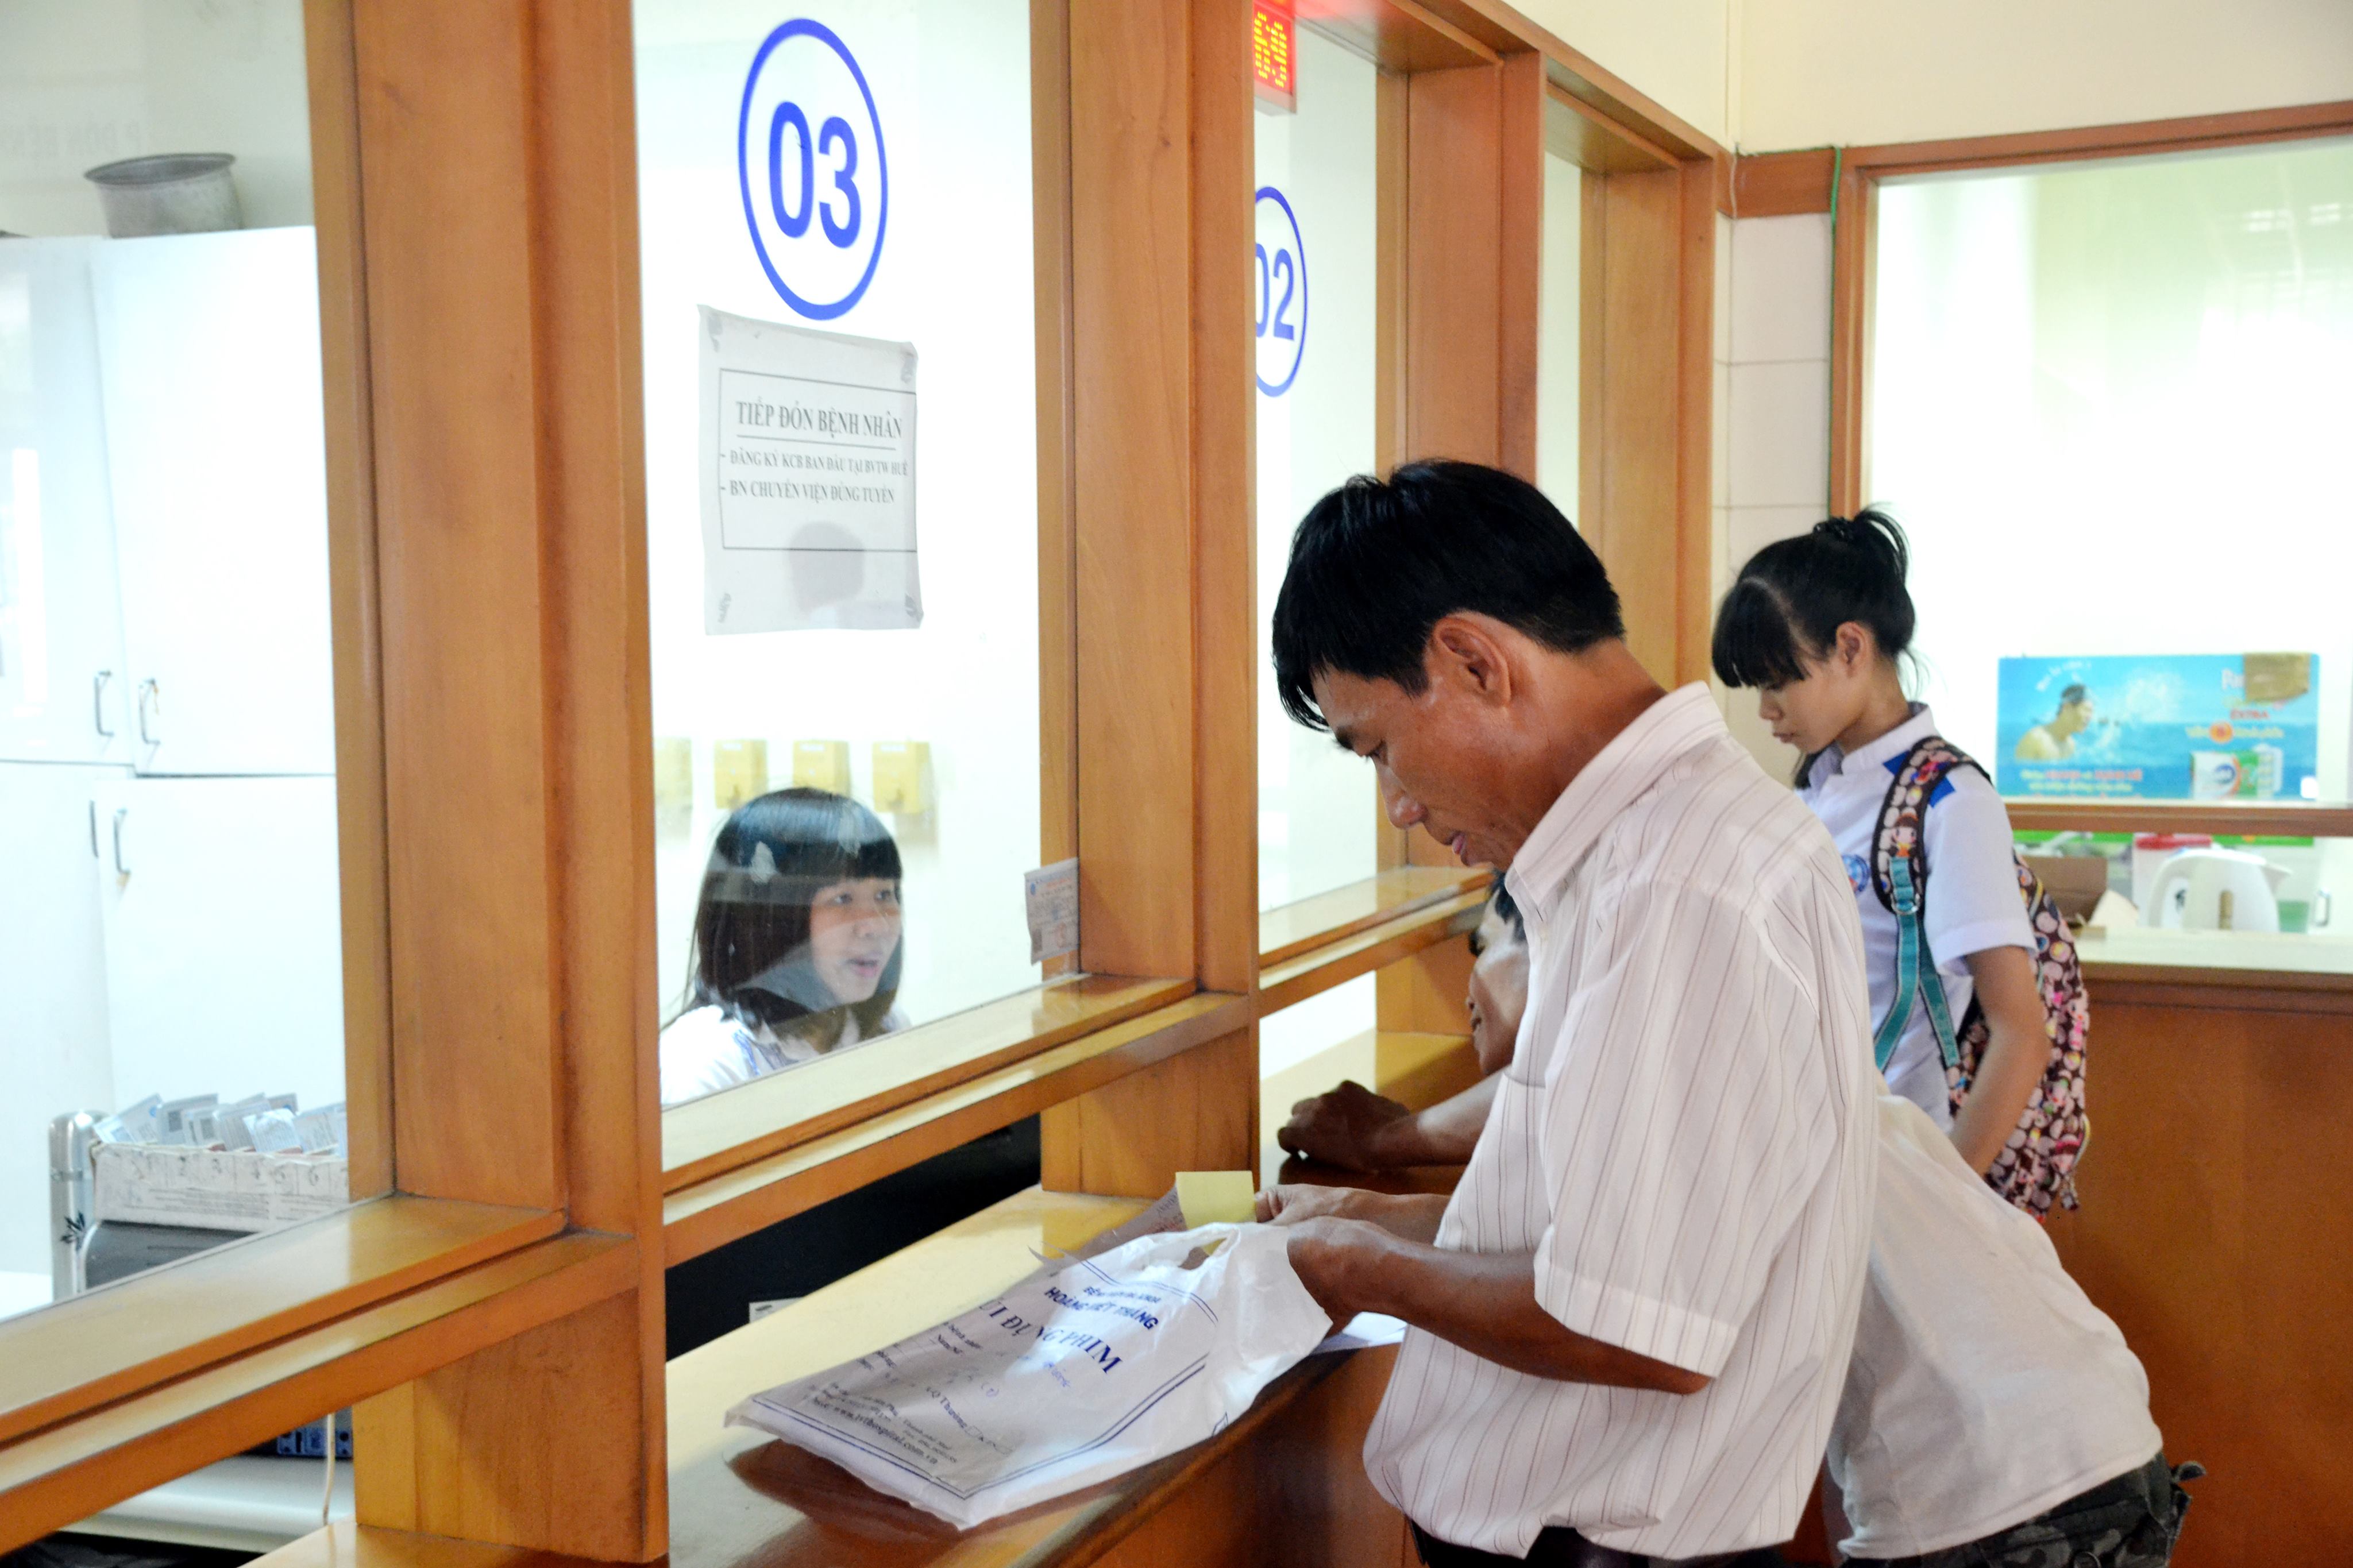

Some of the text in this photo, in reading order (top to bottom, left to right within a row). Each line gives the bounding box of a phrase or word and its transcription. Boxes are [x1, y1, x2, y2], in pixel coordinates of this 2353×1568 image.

[769, 101, 862, 249] 03
[1255, 243, 1295, 341] 02
[818, 407, 859, 438] BỆNH
[730, 480, 747, 496] BN
[1058, 1331, 1124, 1374] PHIM
